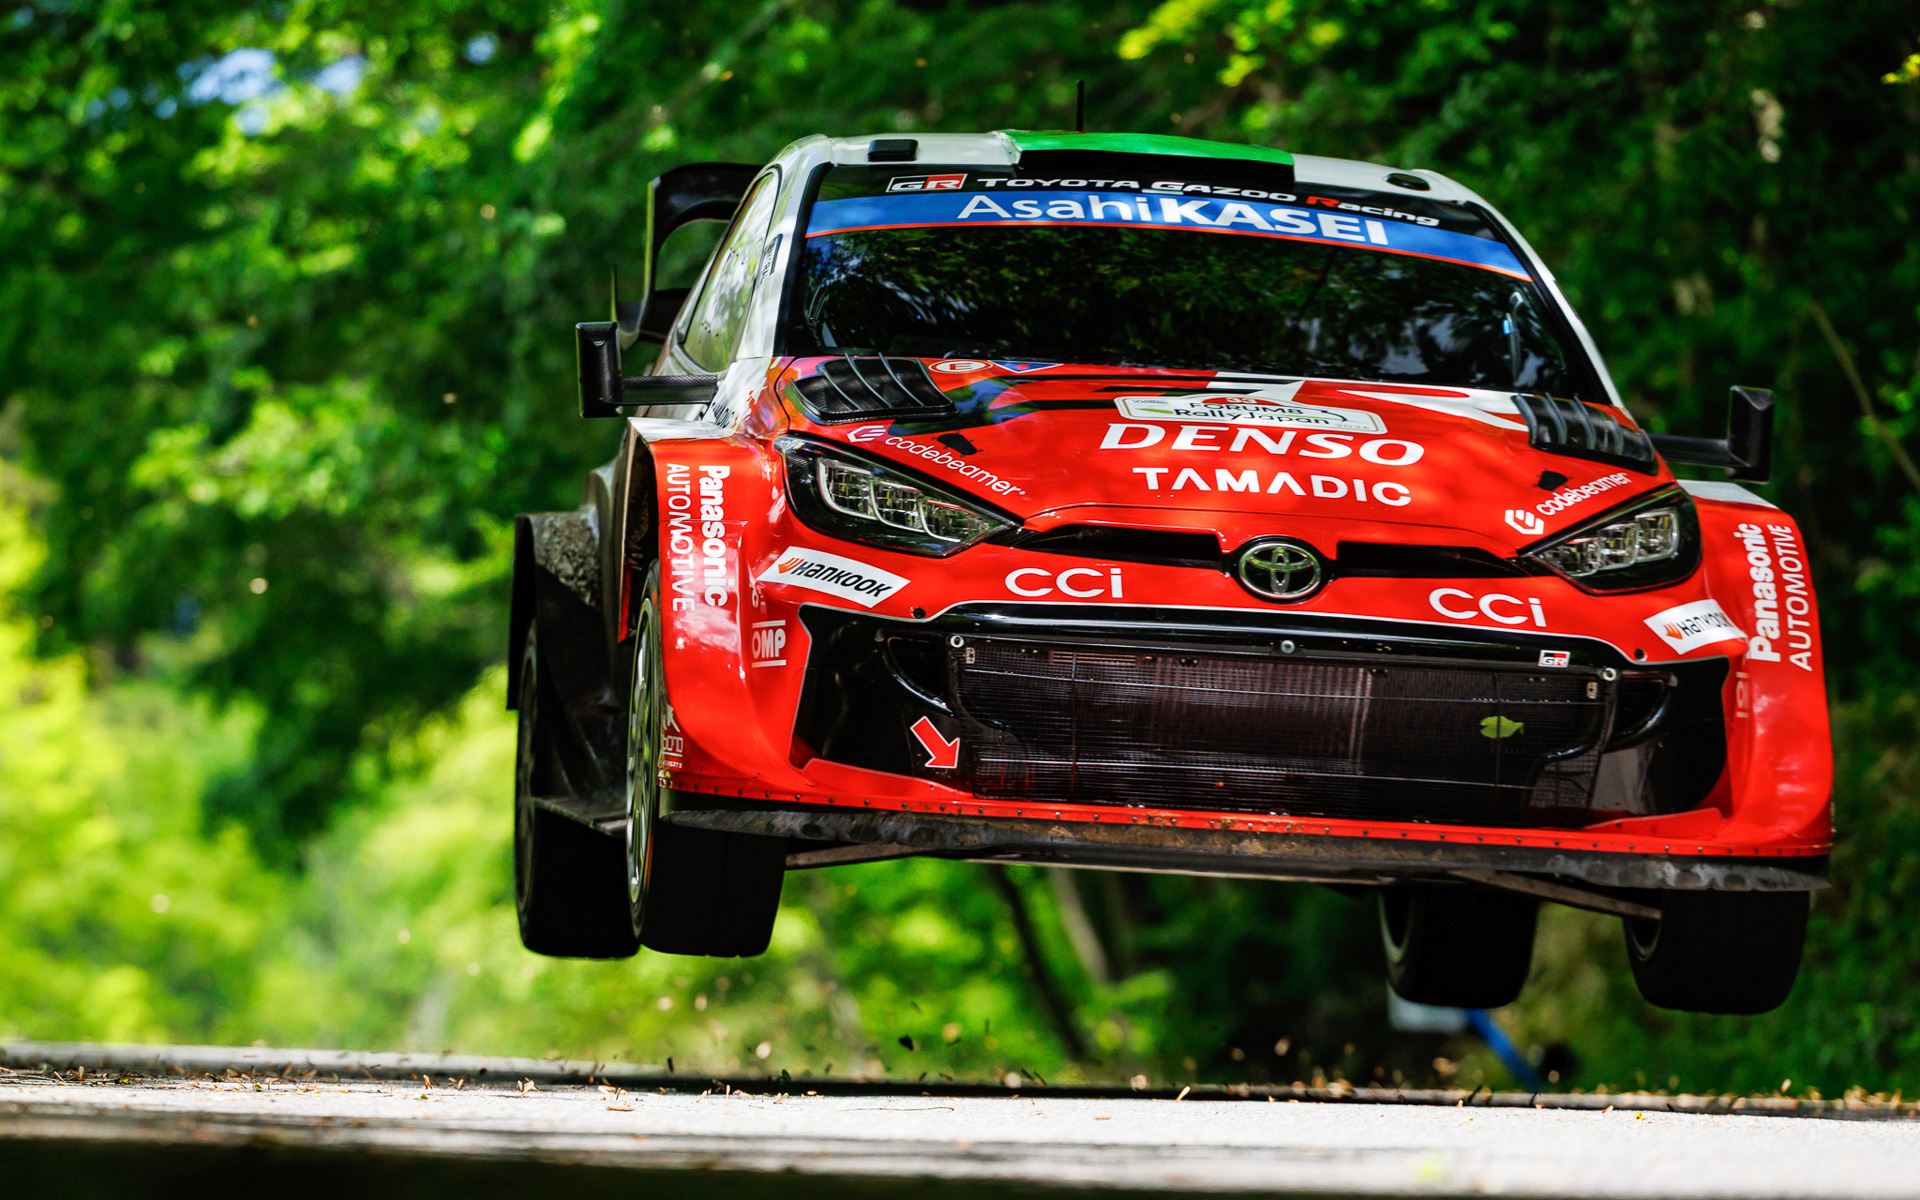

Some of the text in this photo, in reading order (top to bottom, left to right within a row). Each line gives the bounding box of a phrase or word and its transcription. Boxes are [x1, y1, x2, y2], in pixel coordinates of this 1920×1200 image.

[889, 177, 1440, 226] GR TOYOTA GAZOO Racing
[1190, 402, 1303, 415] FORUM8
[885, 436, 1021, 496] codebeamer
[1099, 423, 1425, 466] DENSO
[1132, 467, 1412, 507] TAMADIC
[1536, 472, 1631, 516] codebeamer
[666, 463, 696, 612] AUTOMOTIVE
[699, 465, 736, 607] Panasonic
[1733, 523, 1781, 663] Panasonic
[1767, 524, 1813, 672] AUTOMOTIVE
[752, 628, 787, 659] OMP
[1540, 654, 1568, 666] GR
